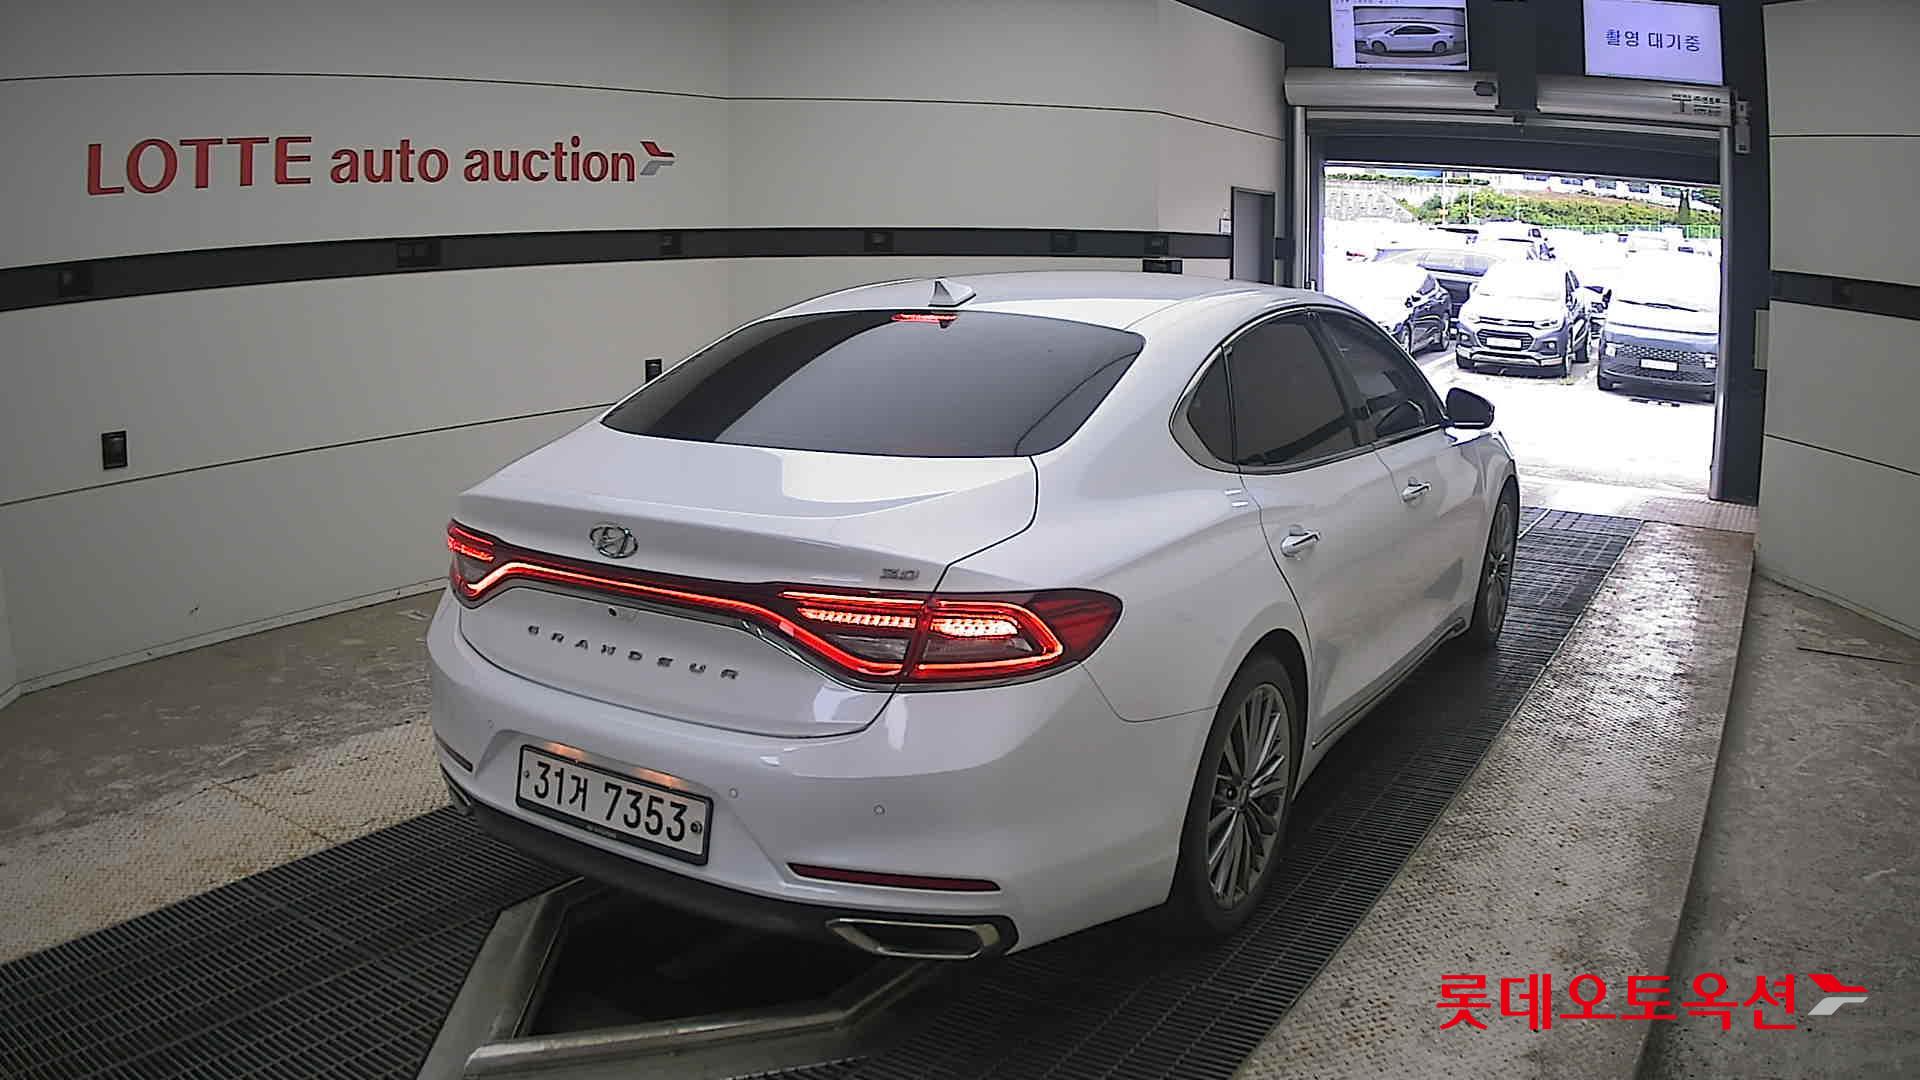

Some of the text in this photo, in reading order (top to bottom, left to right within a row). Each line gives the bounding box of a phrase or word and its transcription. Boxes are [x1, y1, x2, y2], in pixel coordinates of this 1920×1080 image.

[1648, 32, 1701, 52] 대기중
[87, 135, 635, 196] LOTTE auto auction
[527, 624, 739, 680] GRANDEUR
[534, 760, 688, 842] 31거 7353
